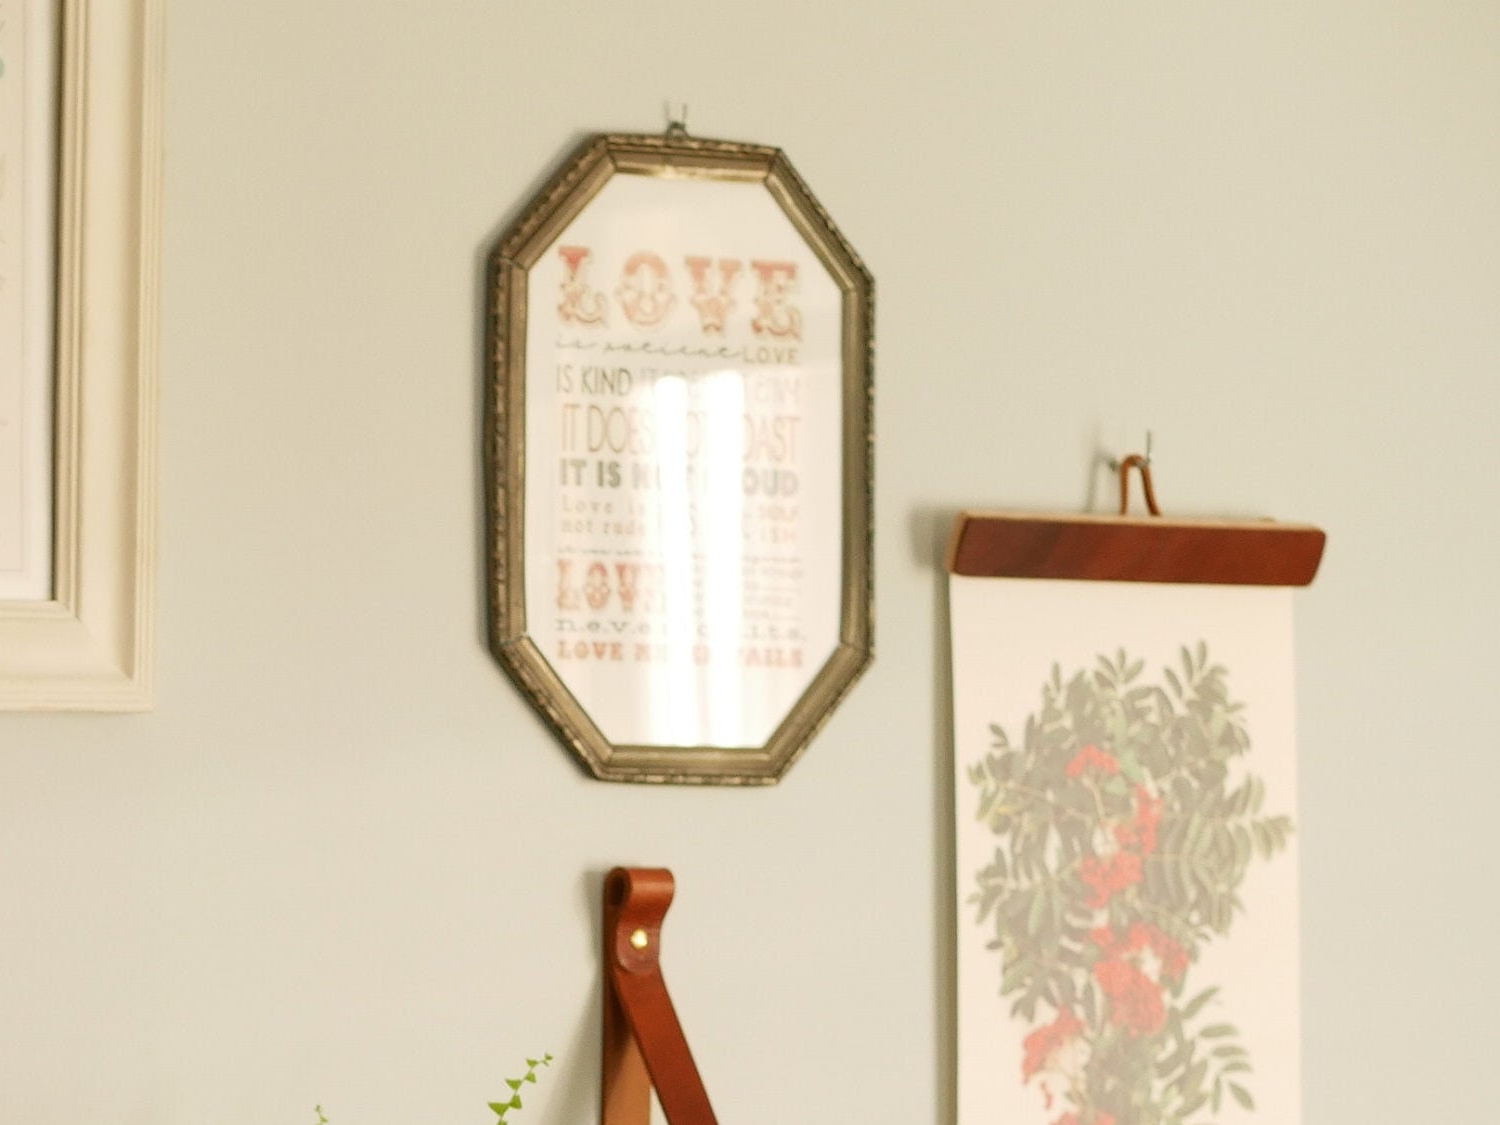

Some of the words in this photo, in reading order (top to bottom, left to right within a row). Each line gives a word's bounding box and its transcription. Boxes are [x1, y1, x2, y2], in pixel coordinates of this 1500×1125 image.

[555, 246, 803, 340] LOVE
[742, 347, 799, 365] LOVE
[556, 364, 573, 394] IS
[580, 367, 632, 397] KIND
[562, 403, 580, 452] IT
[560, 458, 586, 487] IT
[596, 461, 621, 488] IS
[557, 640, 623, 661] LOVE
